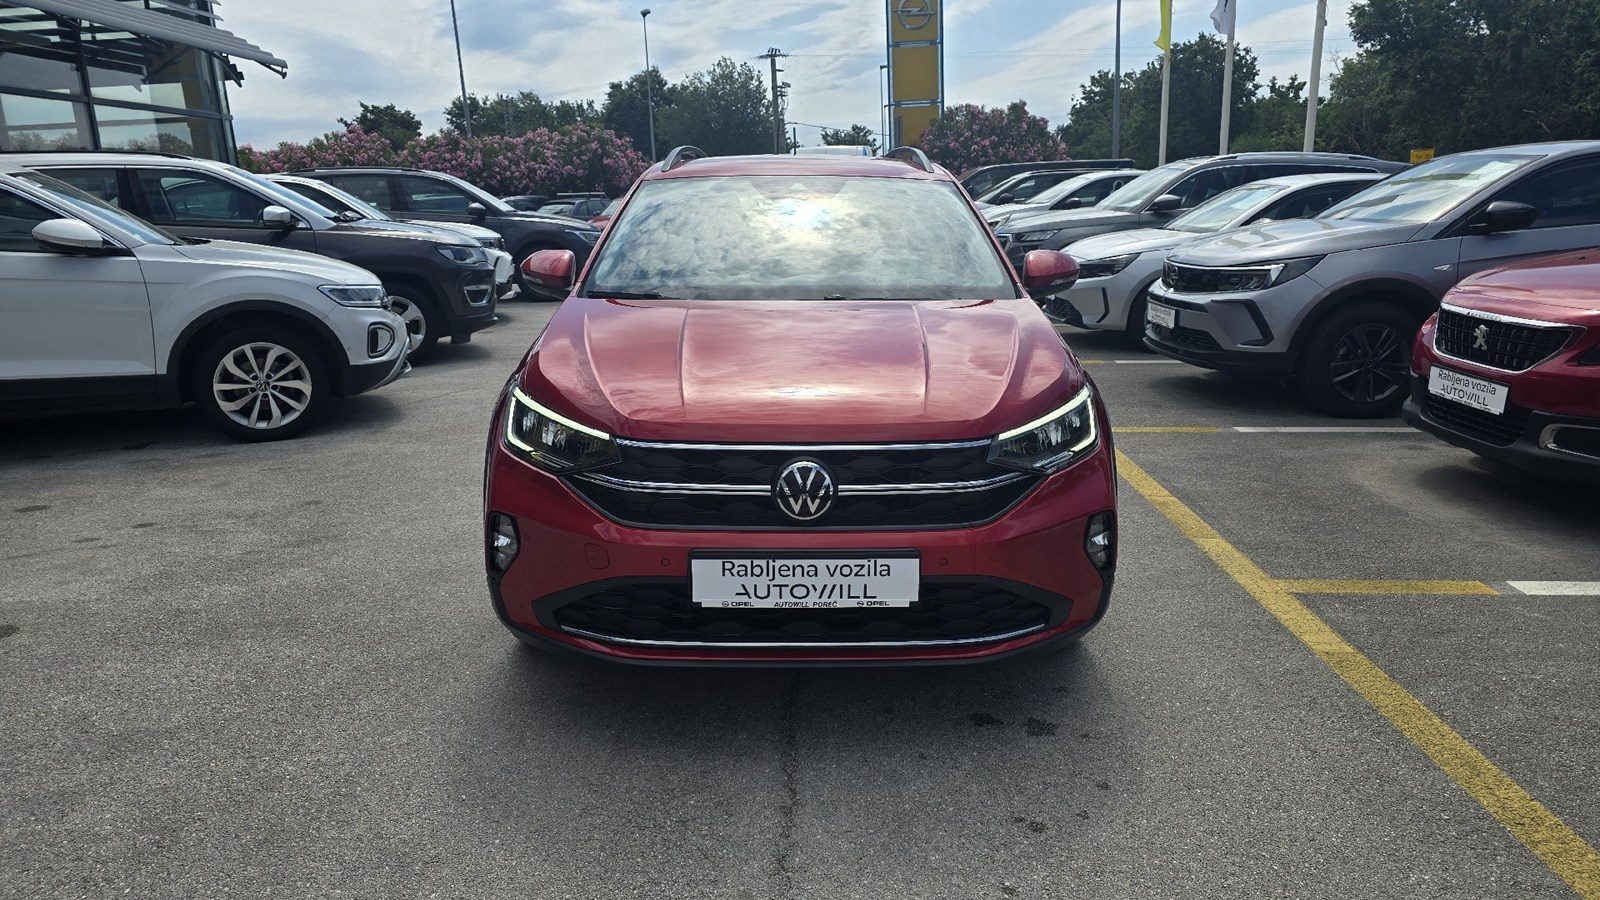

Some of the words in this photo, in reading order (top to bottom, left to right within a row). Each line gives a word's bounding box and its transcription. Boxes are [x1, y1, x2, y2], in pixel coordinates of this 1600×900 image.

[1438, 370, 1470, 388] Rabljena
[1471, 381, 1497, 395] vozila
[721, 560, 818, 581] Rabljena
[826, 559, 891, 577] vozila
[735, 584, 877, 599] AUTOWILL
[813, 600, 838, 608] POREČ
